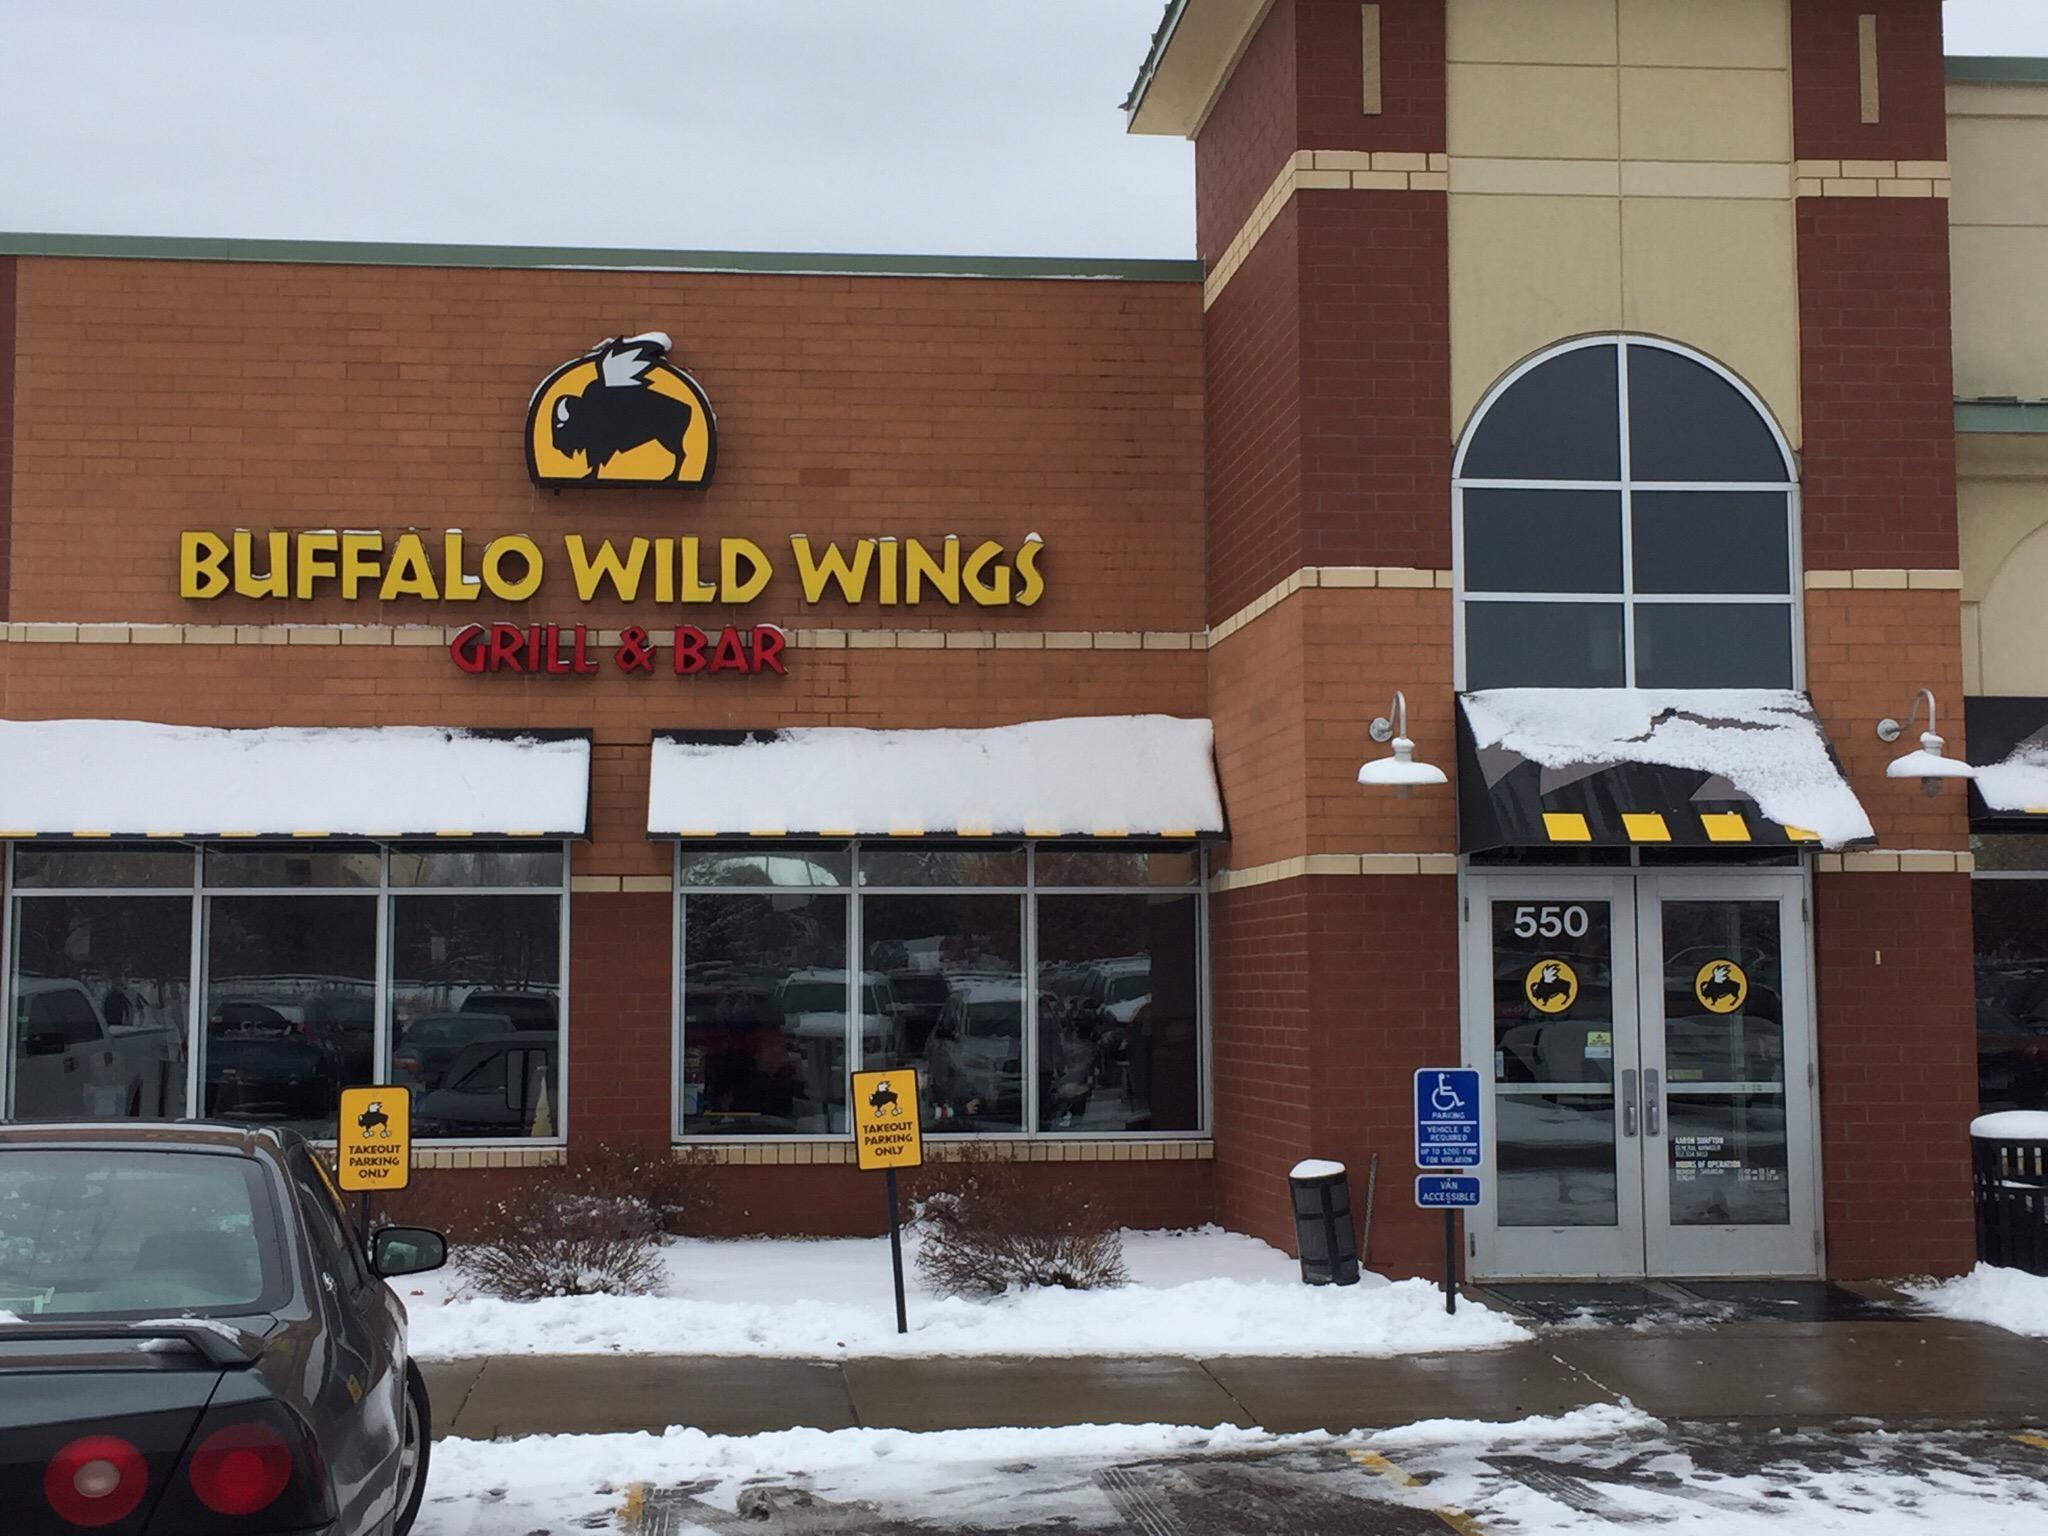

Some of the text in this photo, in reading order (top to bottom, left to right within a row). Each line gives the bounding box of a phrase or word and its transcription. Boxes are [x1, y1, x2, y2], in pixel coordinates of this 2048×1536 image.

[178, 529, 1045, 607] BUFFALO WILD WINGS
[449, 622, 788, 677] GRILL & BAR
[1514, 906, 1588, 938] 550
[863, 1121, 913, 1134] TAKEOUT
[864, 1134, 913, 1145] PARKING
[348, 1145, 401, 1154] TAKEOUT
[875, 1146, 904, 1156] ONLY
[349, 1157, 399, 1166] PARKING
[358, 1169, 390, 1178] ONLY
[1440, 1181, 1458, 1190] VAN
[1423, 1193, 1476, 1201] ACCESSIBLE
